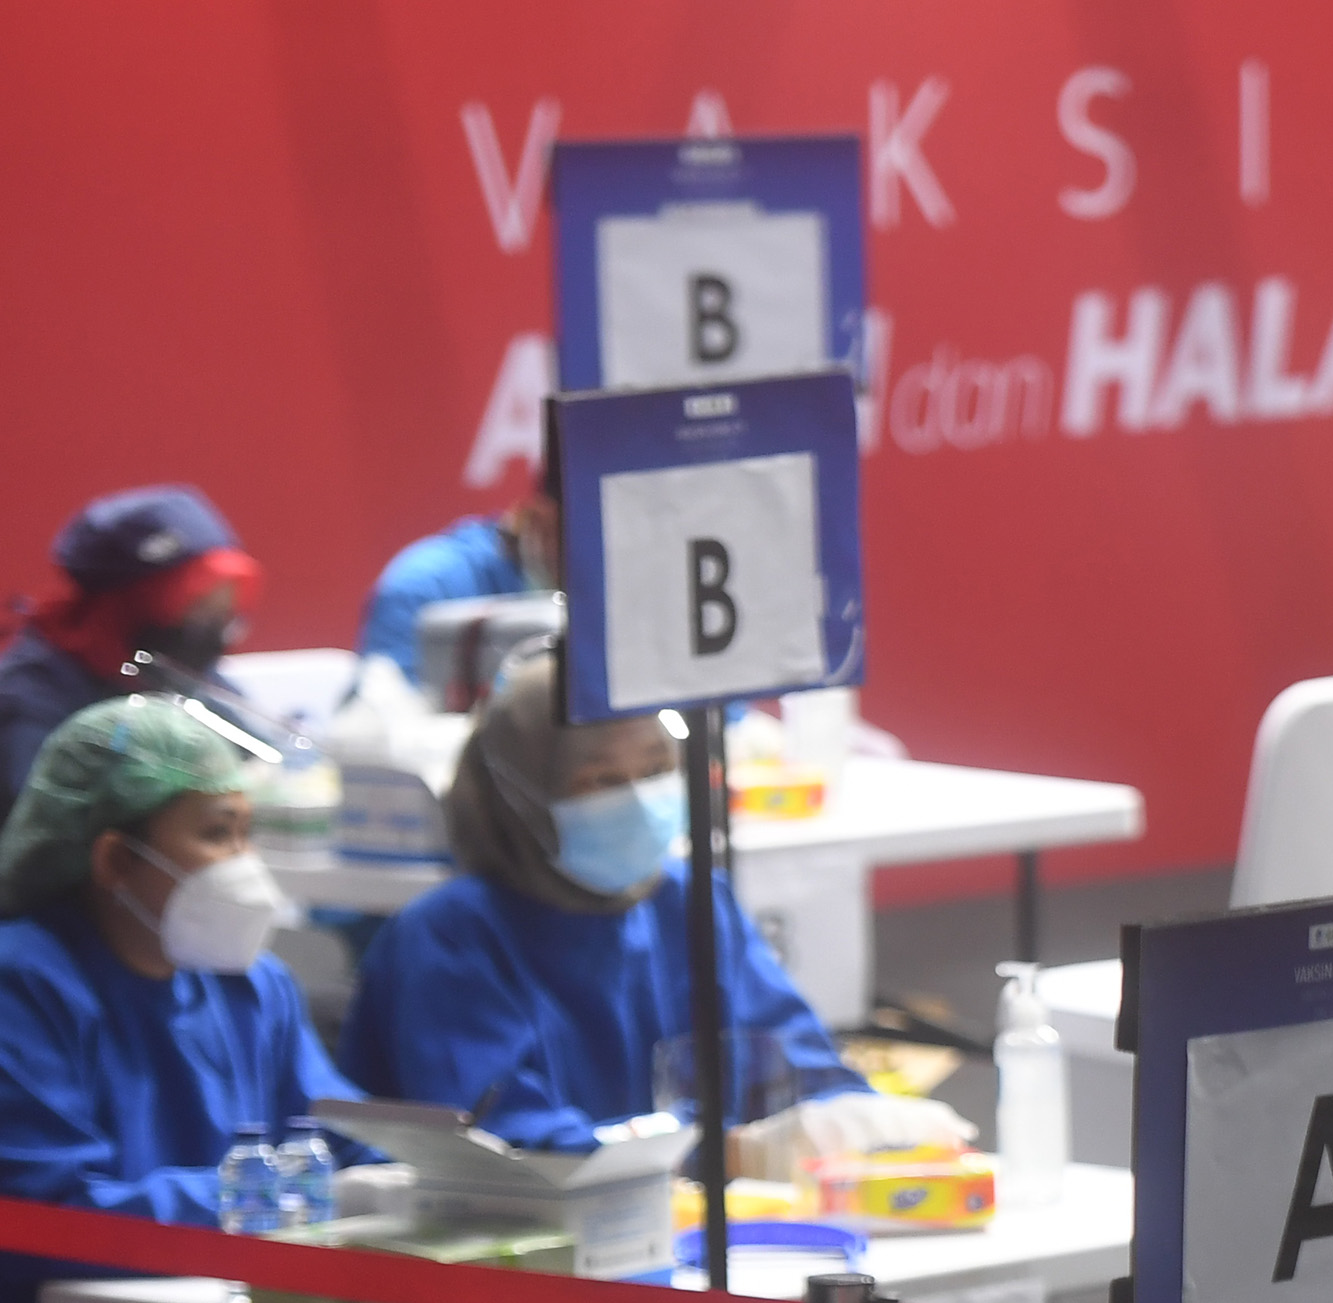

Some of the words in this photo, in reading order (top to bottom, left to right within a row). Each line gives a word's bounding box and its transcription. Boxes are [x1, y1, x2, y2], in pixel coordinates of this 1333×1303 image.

[688, 272, 740, 367] B
[687, 537, 740, 657] B
[1293, 962, 1333, 984] VAKSIN
